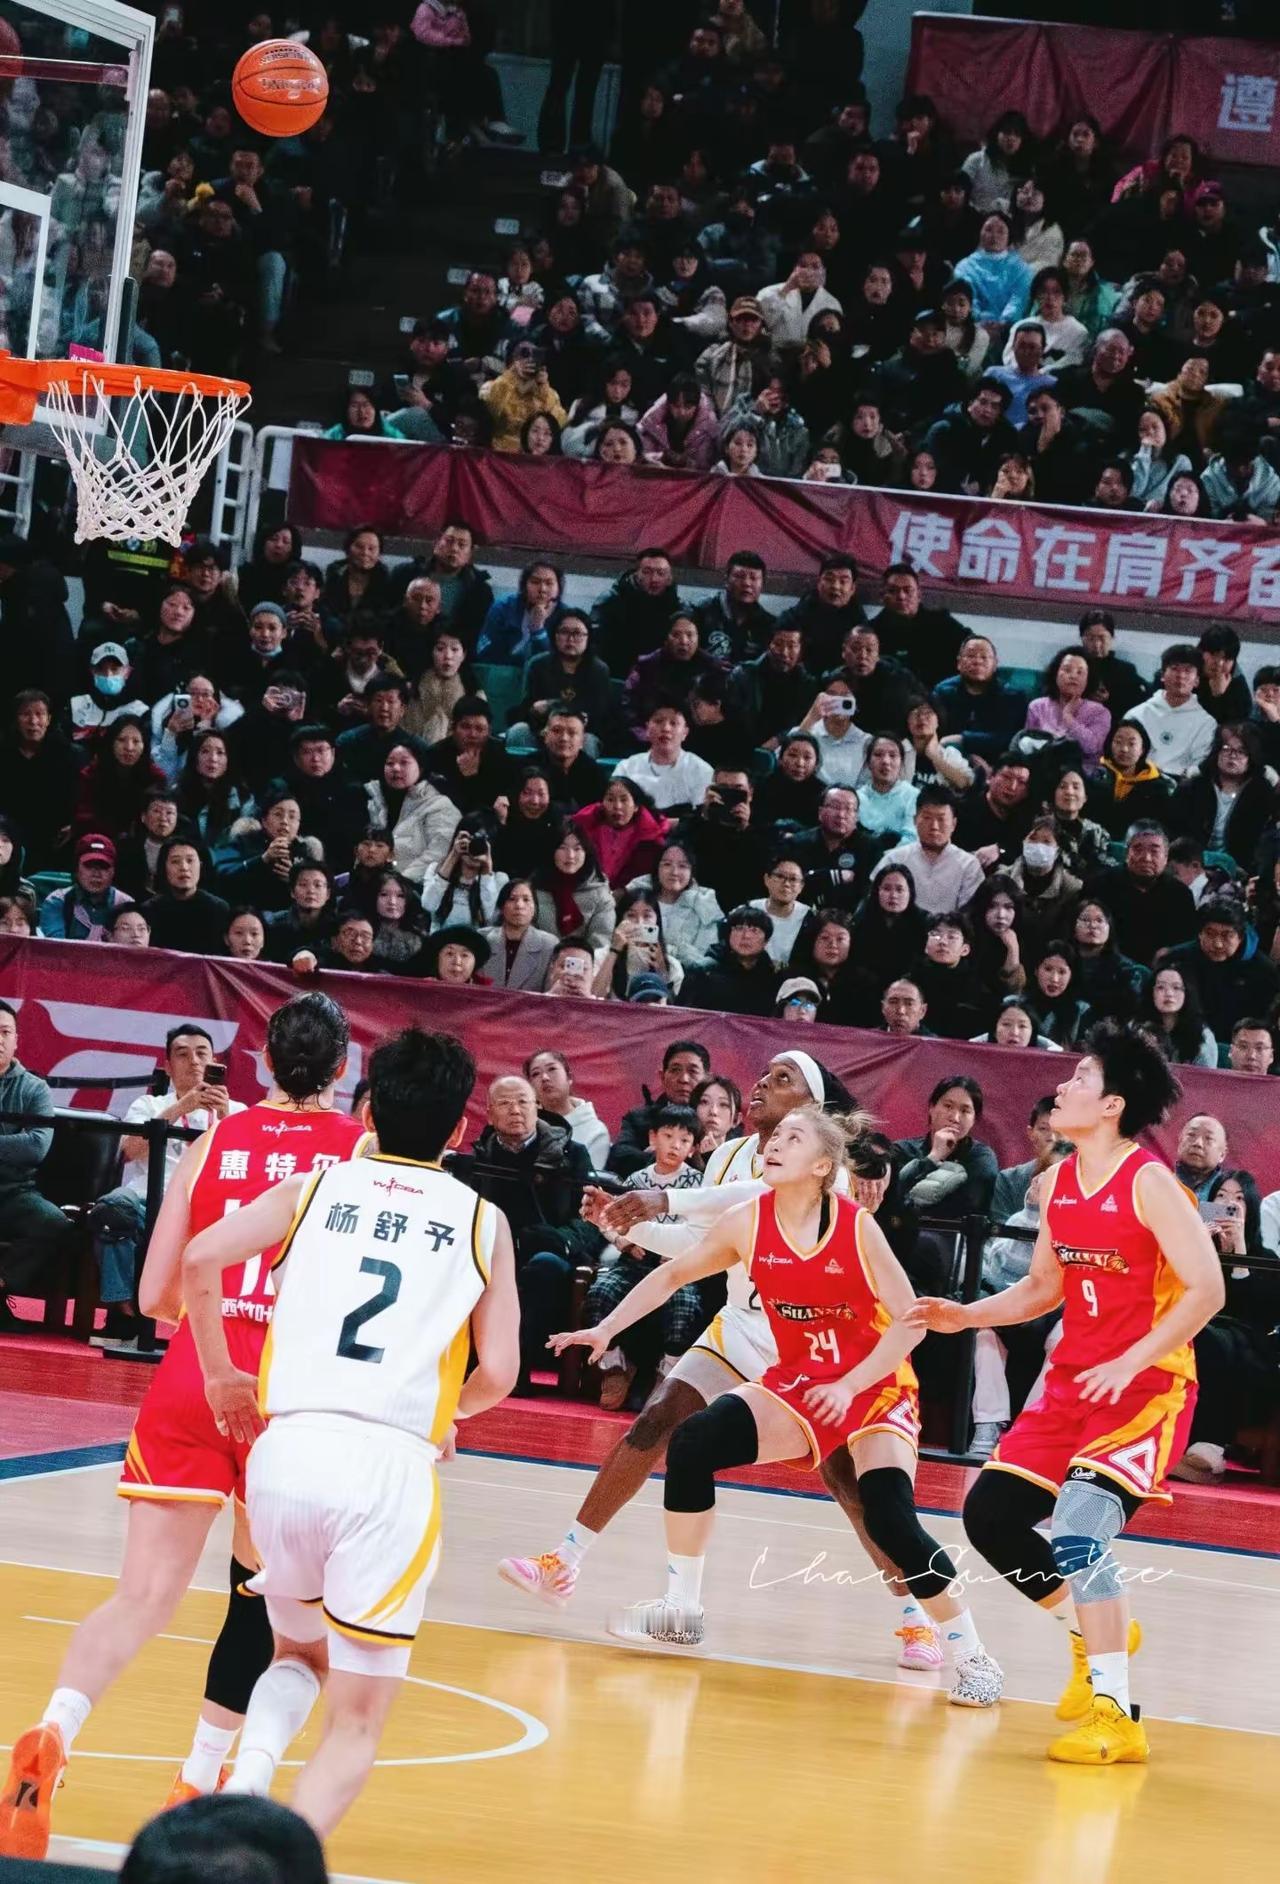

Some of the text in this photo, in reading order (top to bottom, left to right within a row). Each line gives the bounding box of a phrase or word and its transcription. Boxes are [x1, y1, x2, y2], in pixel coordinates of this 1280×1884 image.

[325, 1202, 455, 1252] 杨舒予
[336, 1256, 402, 1364] 2
[1081, 1279, 1098, 1317] 9
[803, 1328, 840, 1364] 24
